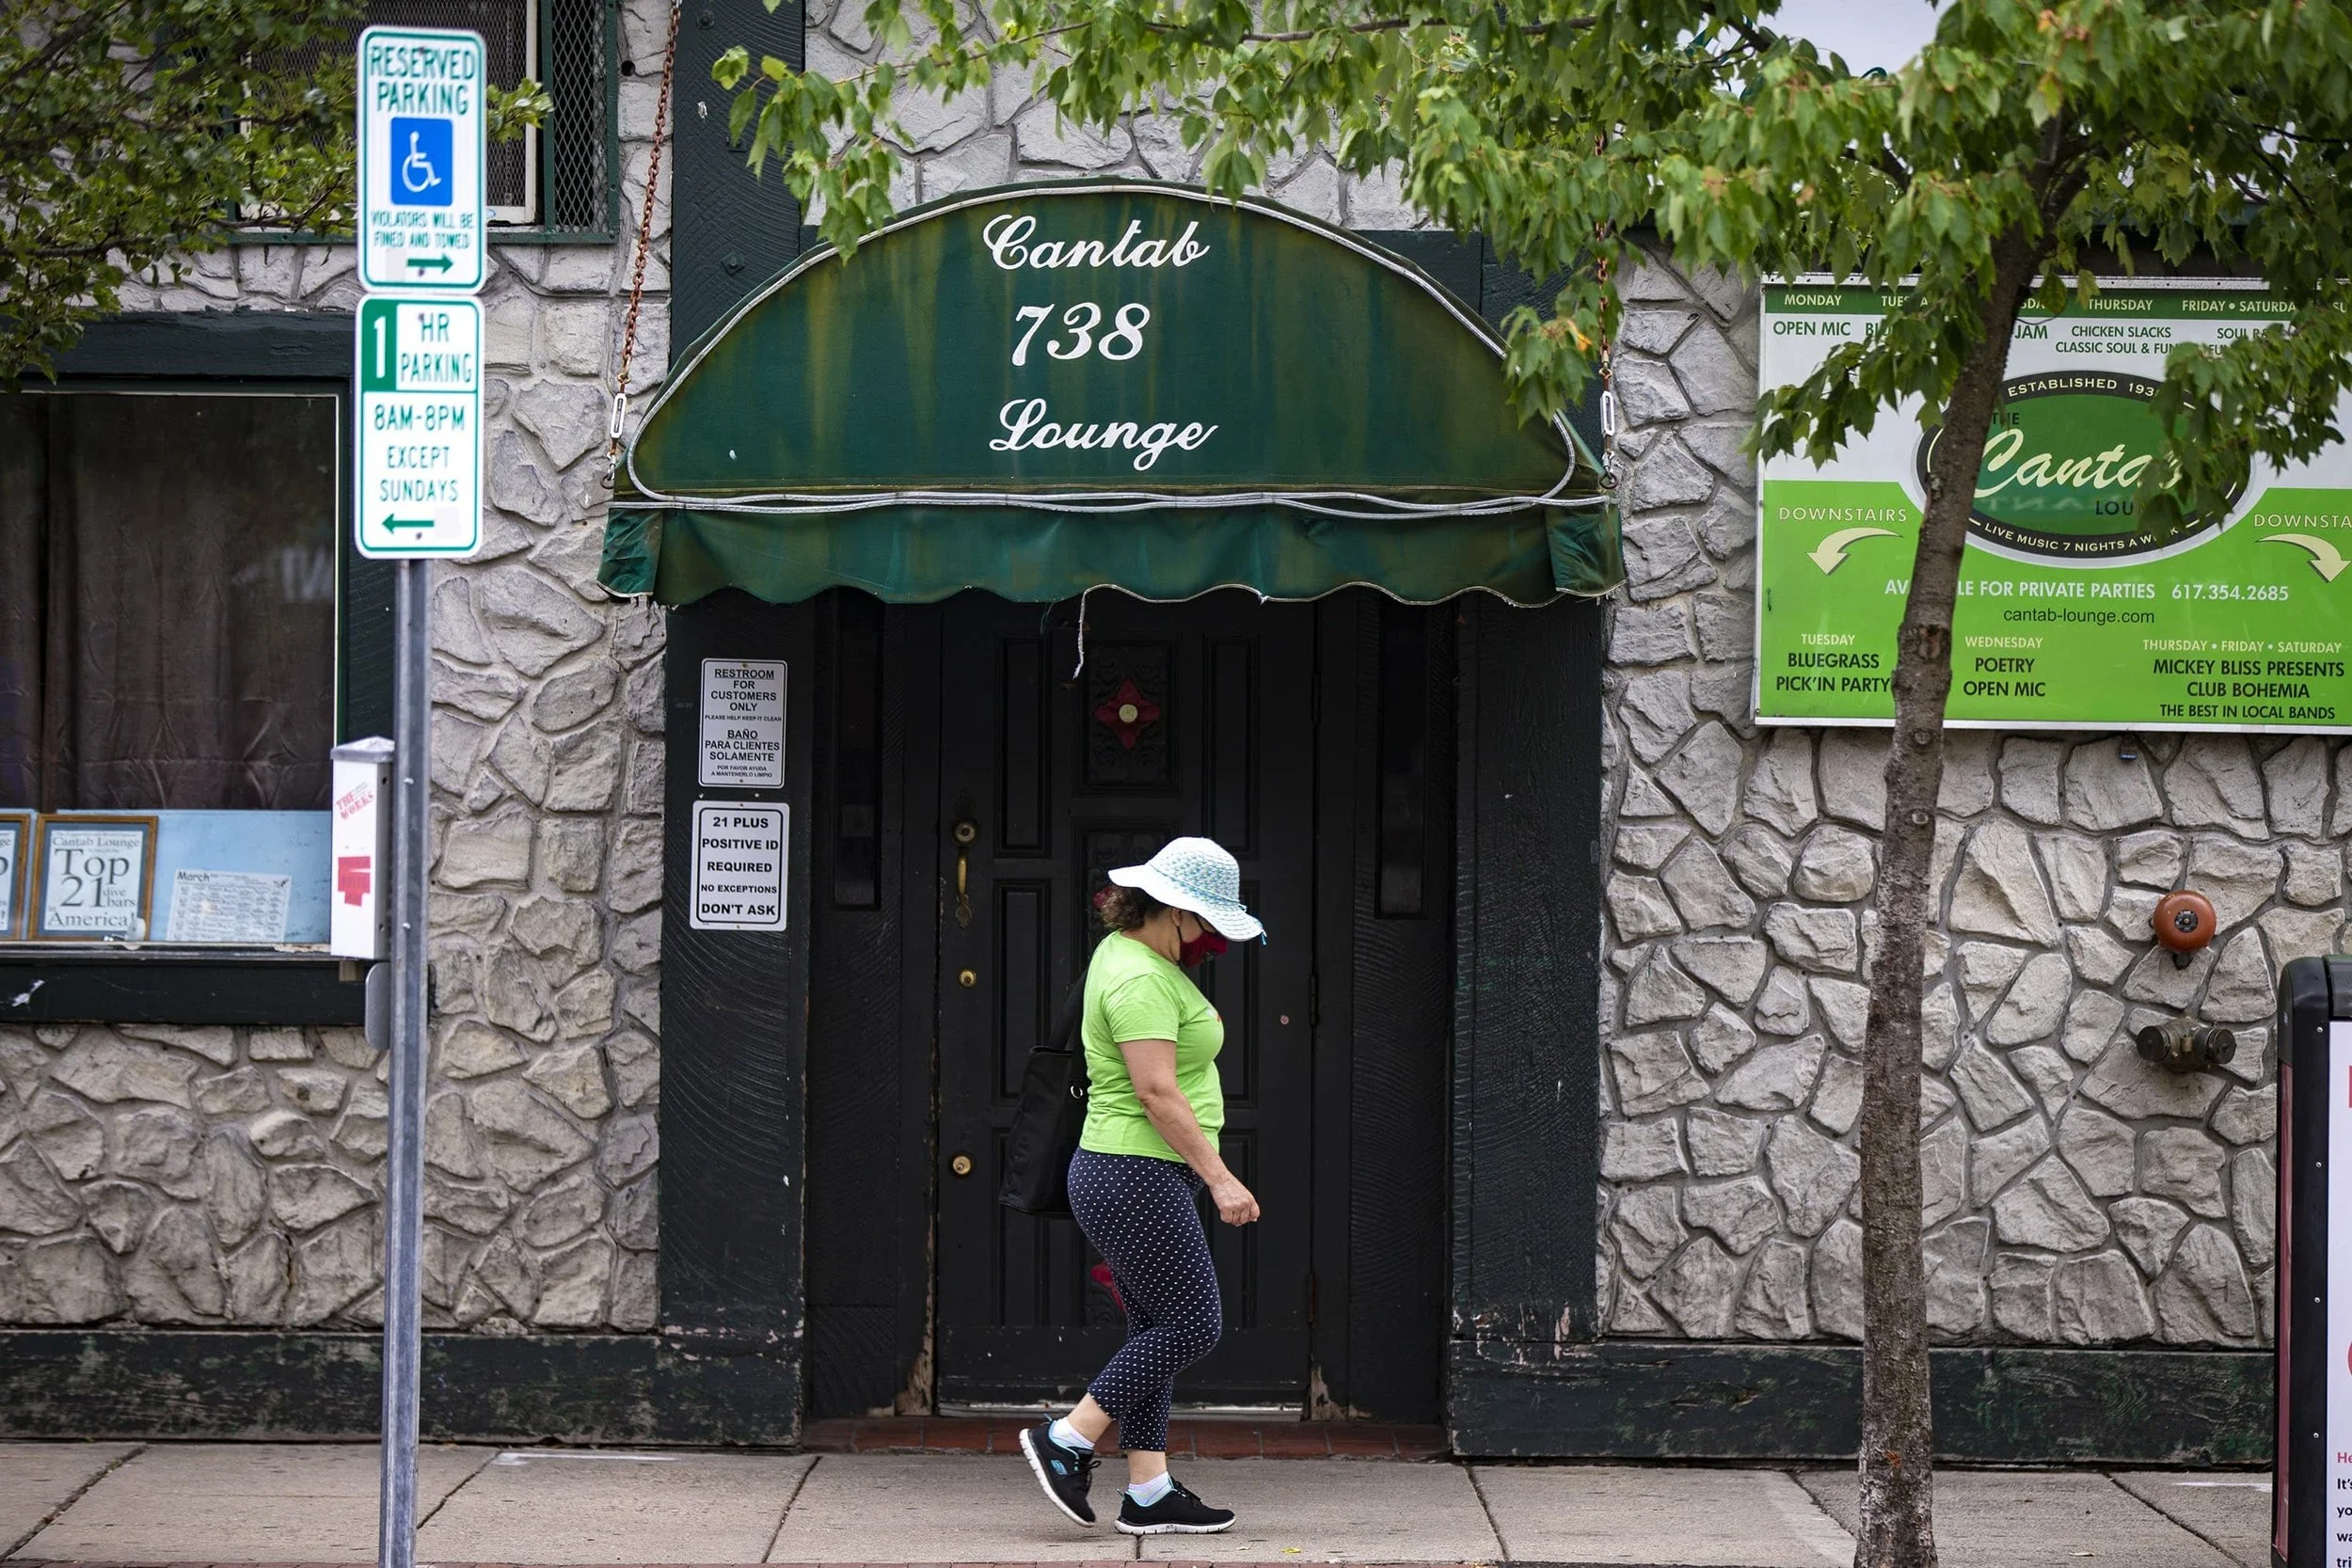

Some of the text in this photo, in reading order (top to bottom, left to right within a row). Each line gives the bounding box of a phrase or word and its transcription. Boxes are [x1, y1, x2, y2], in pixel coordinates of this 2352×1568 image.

[370, 45, 475, 81] RESERVED
[377, 82, 469, 115] PARKING
[372, 211, 473, 229] VIOLATORS WILL BE
[374, 231, 469, 249] FINED AND TOWED
[983, 214, 1211, 270] Cantab
[1784, 294, 1843, 307] MONDAY
[2089, 299, 2153, 311] THURSDAY
[2182, 300, 2296, 312] FRIDAY SATURDA
[421, 313, 450, 342] HR
[1011, 302, 1151, 366] 738
[1772, 321, 1817, 337] OPEN
[1821, 321, 1851, 337] MIC
[2014, 325, 2048, 339] JAM
[2072, 325, 2171, 338] CHICKEN SLACKS
[373, 316, 386, 378] 1
[2056, 341, 2103, 353] CLASSIC
[2106, 342, 2137, 354] SOUL
[2141, 342, 2150, 354] &
[401, 353, 471, 383] PARKING
[2008, 378, 2158, 397] ESTABLISHED 193
[374, 404, 465, 431] 8AM-8PM
[989, 398, 1219, 471] Lounge
[387, 446, 450, 468] EXCEPT
[380, 480, 458, 502] SUNDAYS
[1779, 507, 1907, 522] DOWNSTAIRS
[1984, 522, 2012, 540] LIVE
[2016, 534, 2058, 550] MUSIC
[2063, 542, 2070, 551] 7
[2074, 540, 2124, 552] NIGHTS
[2128, 538, 2137, 547] A
[1980, 580, 2013, 596] FOR
[2019, 581, 2085, 598] PRIVATE
[2090, 582, 2155, 599] PARTIES
[2171, 584, 2289, 601] 617.354.2685
[2003, 608, 2155, 626] cantab-lounge.com
[1801, 633, 1855, 645] TUESDAY
[1965, 636, 2042, 648] WEDNESDAY
[2142, 640, 2342, 654] THURSDAY FRIDAY SATURDAY
[1788, 653, 1880, 669] BLUEGRASS
[1975, 657, 2035, 673] POETRY
[2153, 659, 2344, 676] MICKEY BLISS PRESENTS
[715, 669, 774, 679] RESTROOM
[733, 680, 755, 689] FOR
[1841, 676, 1890, 692] PARTY
[1963, 681, 2046, 697] OPEN MIC
[2187, 682, 2310, 698] CLUB BOHEMIA
[710, 691, 777, 701] CUSTOMERS
[730, 703, 757, 711] ONLY
[2160, 705, 2336, 720] THE BEST IN LOCAL BANDS
[727, 729, 758, 739] BAÑO
[705, 740, 780, 751] PARA CLIENTES
[709, 752, 774, 762] SOLAMENTE
[713, 816, 769, 829] 21 PLUS
[702, 838, 779, 849] POSITIVE ID
[55, 848, 130, 885] Top
[707, 862, 772, 873] REQUIRED
[60, 876, 104, 908] 21
[718, 885, 777, 894] EXCEPTIONS
[702, 903, 775, 915] DON'T ASK
